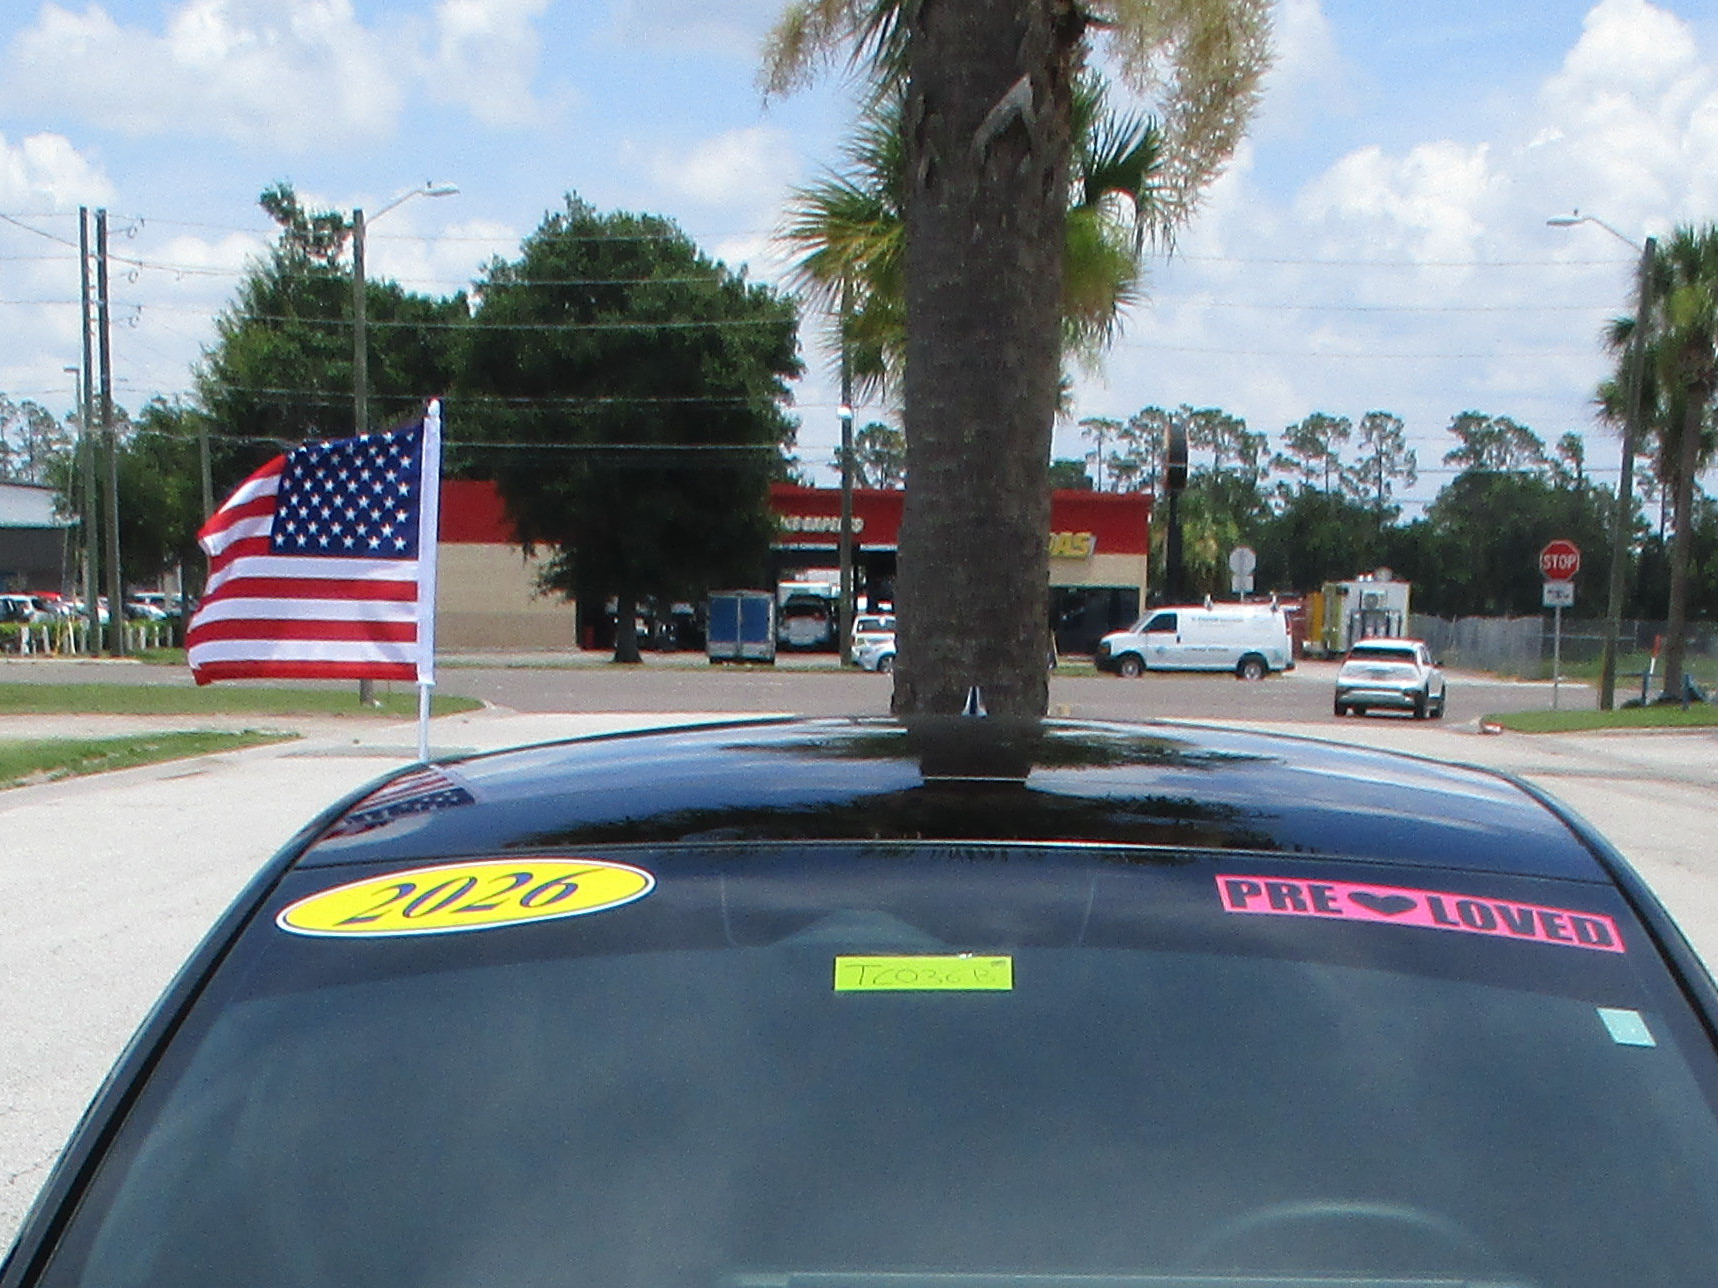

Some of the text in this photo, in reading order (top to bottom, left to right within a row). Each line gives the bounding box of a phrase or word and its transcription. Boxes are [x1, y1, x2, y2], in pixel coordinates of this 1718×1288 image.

[1543, 554, 1577, 570] STOP
[333, 868, 606, 927] 2026
[1226, 879, 1616, 948] PRE LOVED
